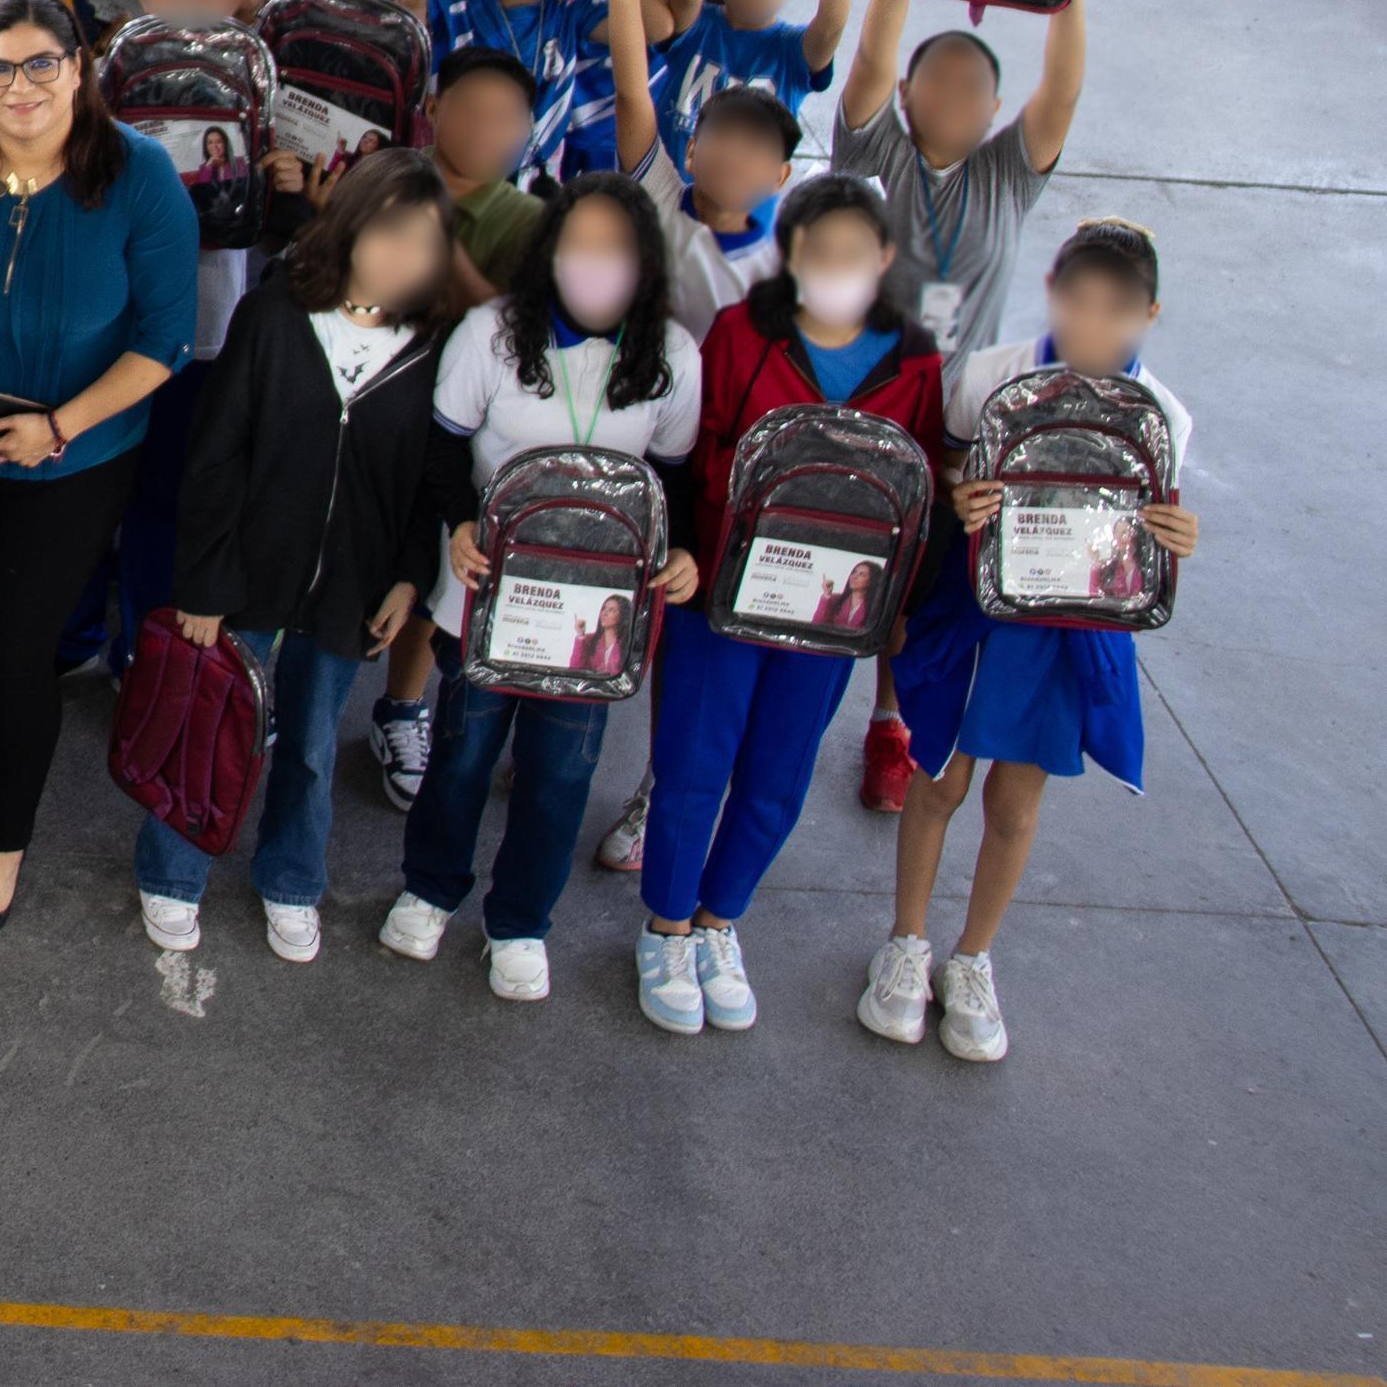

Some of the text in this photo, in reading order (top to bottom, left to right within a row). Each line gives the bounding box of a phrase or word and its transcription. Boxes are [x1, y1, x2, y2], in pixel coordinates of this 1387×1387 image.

[282, 98, 330, 124] VELÁZQUEZ
[288, 92, 329, 115] BRENDA
[1018, 513, 1067, 524] BRENDA
[1014, 526, 1072, 535] VELÁZQUEZ
[765, 544, 811, 560] BRENDA
[759, 555, 813, 569] VELÁZQUEZ
[514, 583, 561, 599] BRENDA
[508, 595, 563, 609] VELÁZQUEZ
